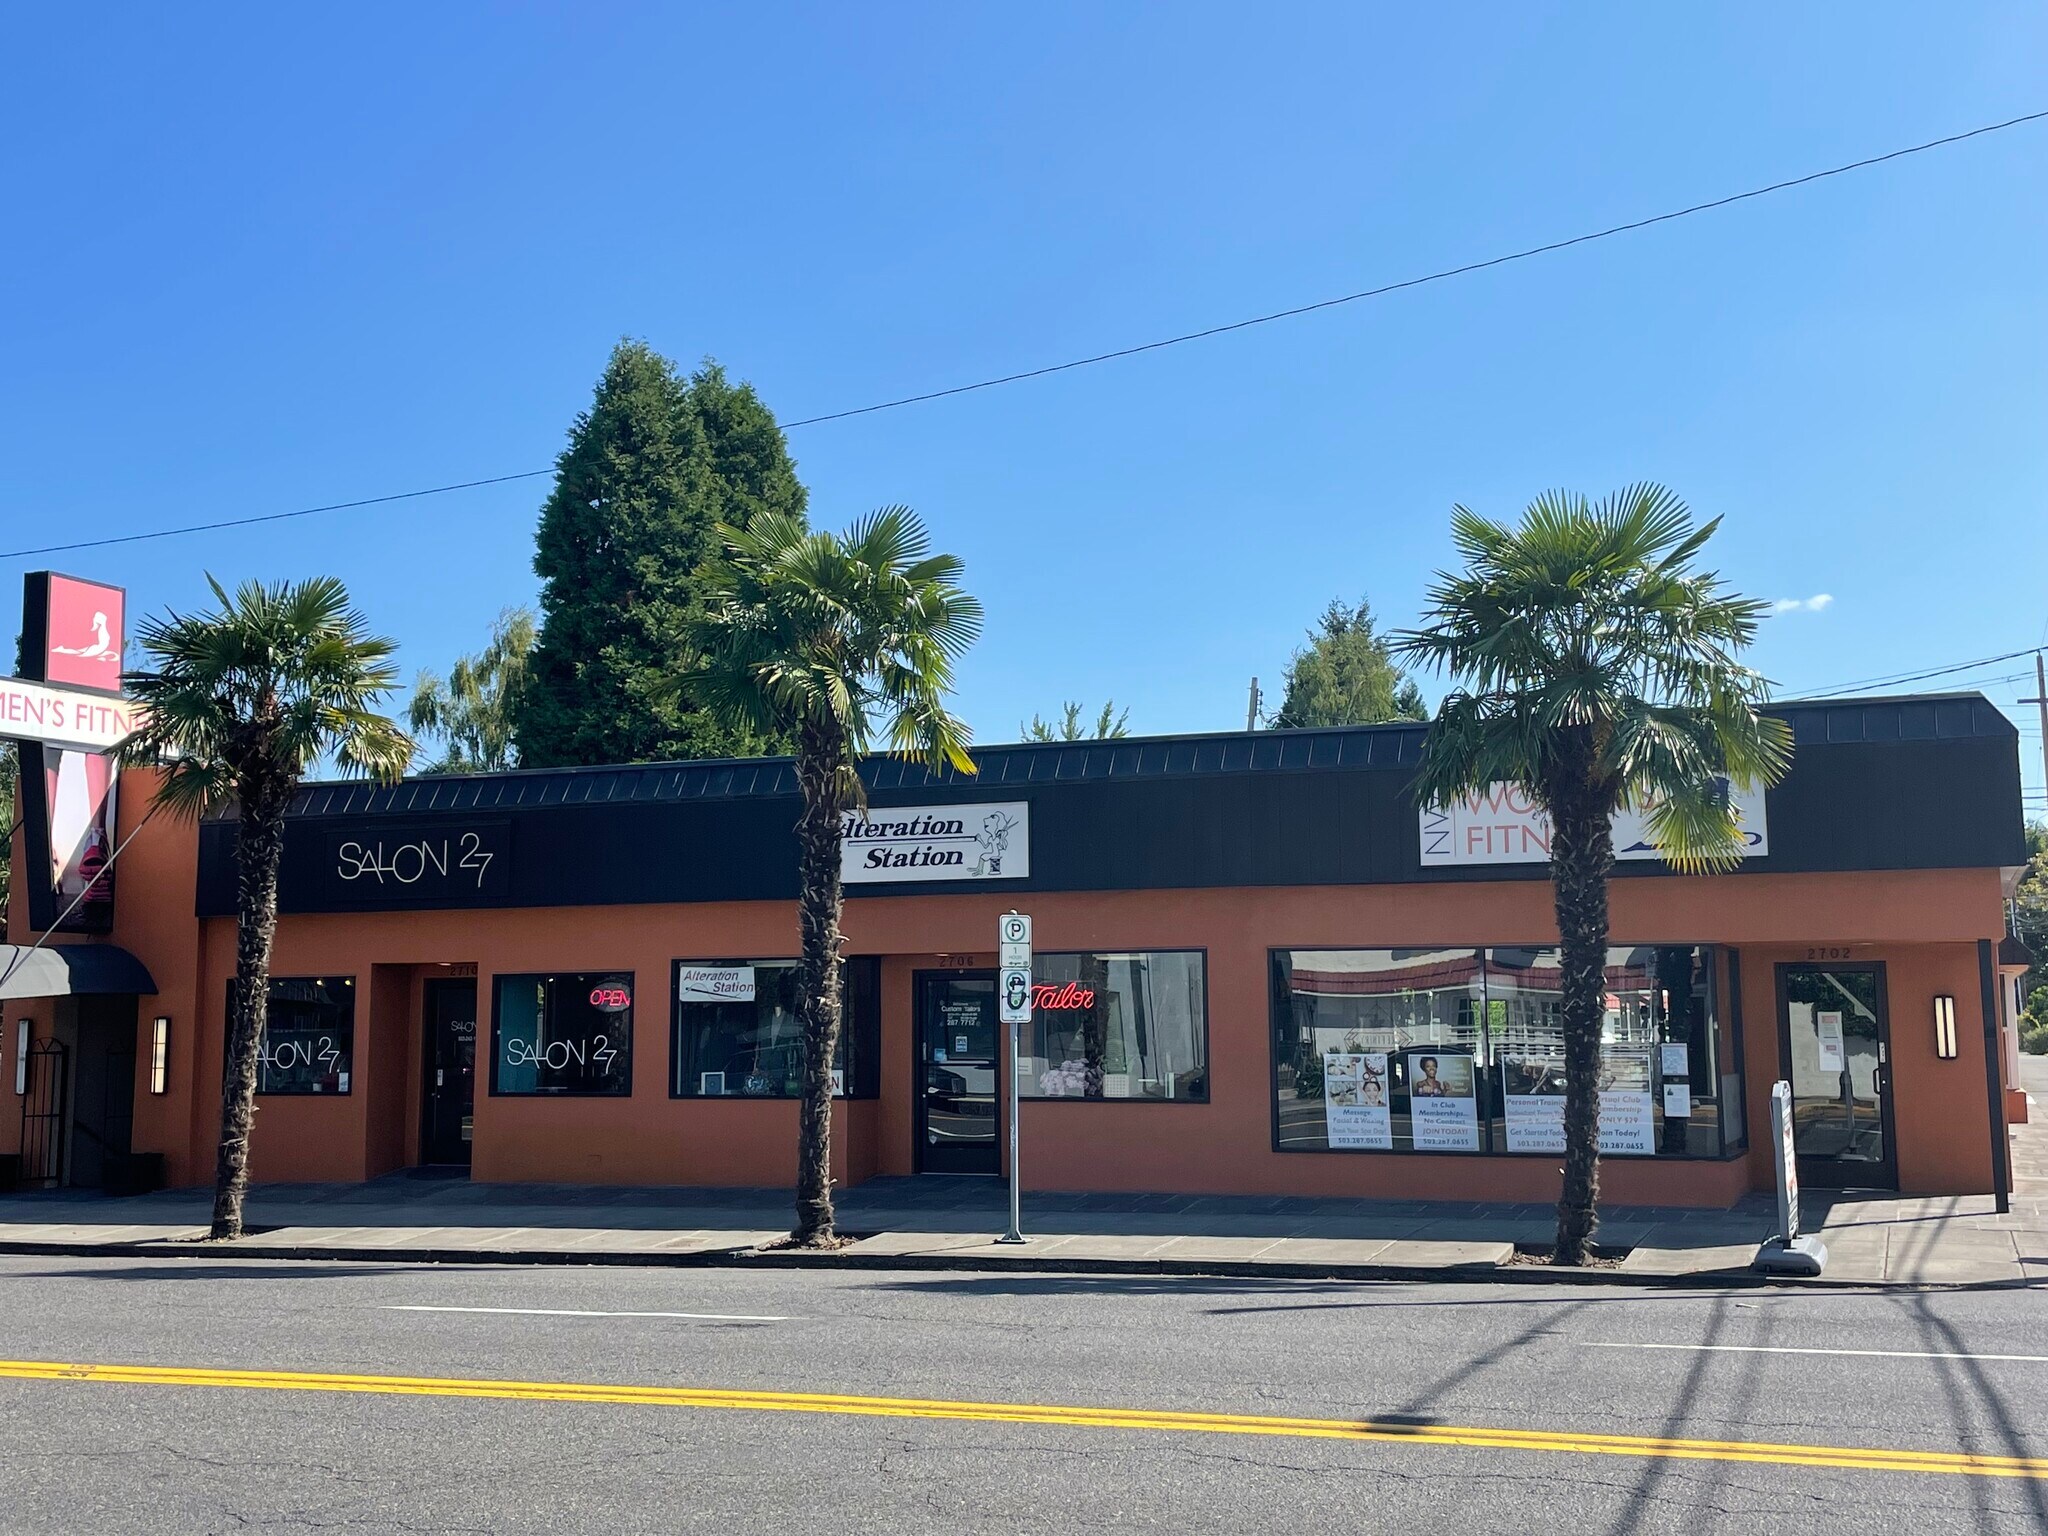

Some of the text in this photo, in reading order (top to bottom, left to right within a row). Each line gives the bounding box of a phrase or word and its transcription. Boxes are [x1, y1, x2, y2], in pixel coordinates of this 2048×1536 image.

[841, 815, 964, 839] lteration
[337, 832, 494, 888] SALON 27
[863, 846, 964, 869] Station
[1011, 923, 1021, 937] P
[1807, 947, 1851, 959] 2702
[939, 956, 974, 967] 2706
[683, 969, 739, 981] Alteration
[713, 981, 754, 993] Station
[590, 989, 631, 1007] OPEN
[1031, 982, 1094, 1009] Tailor
[256, 1036, 340, 1074] ALON 27
[506, 1035, 617, 1074] SALON 27
[1614, 1129, 1640, 1138] Today!
[1599, 1141, 1644, 1149] 03.287.0655
